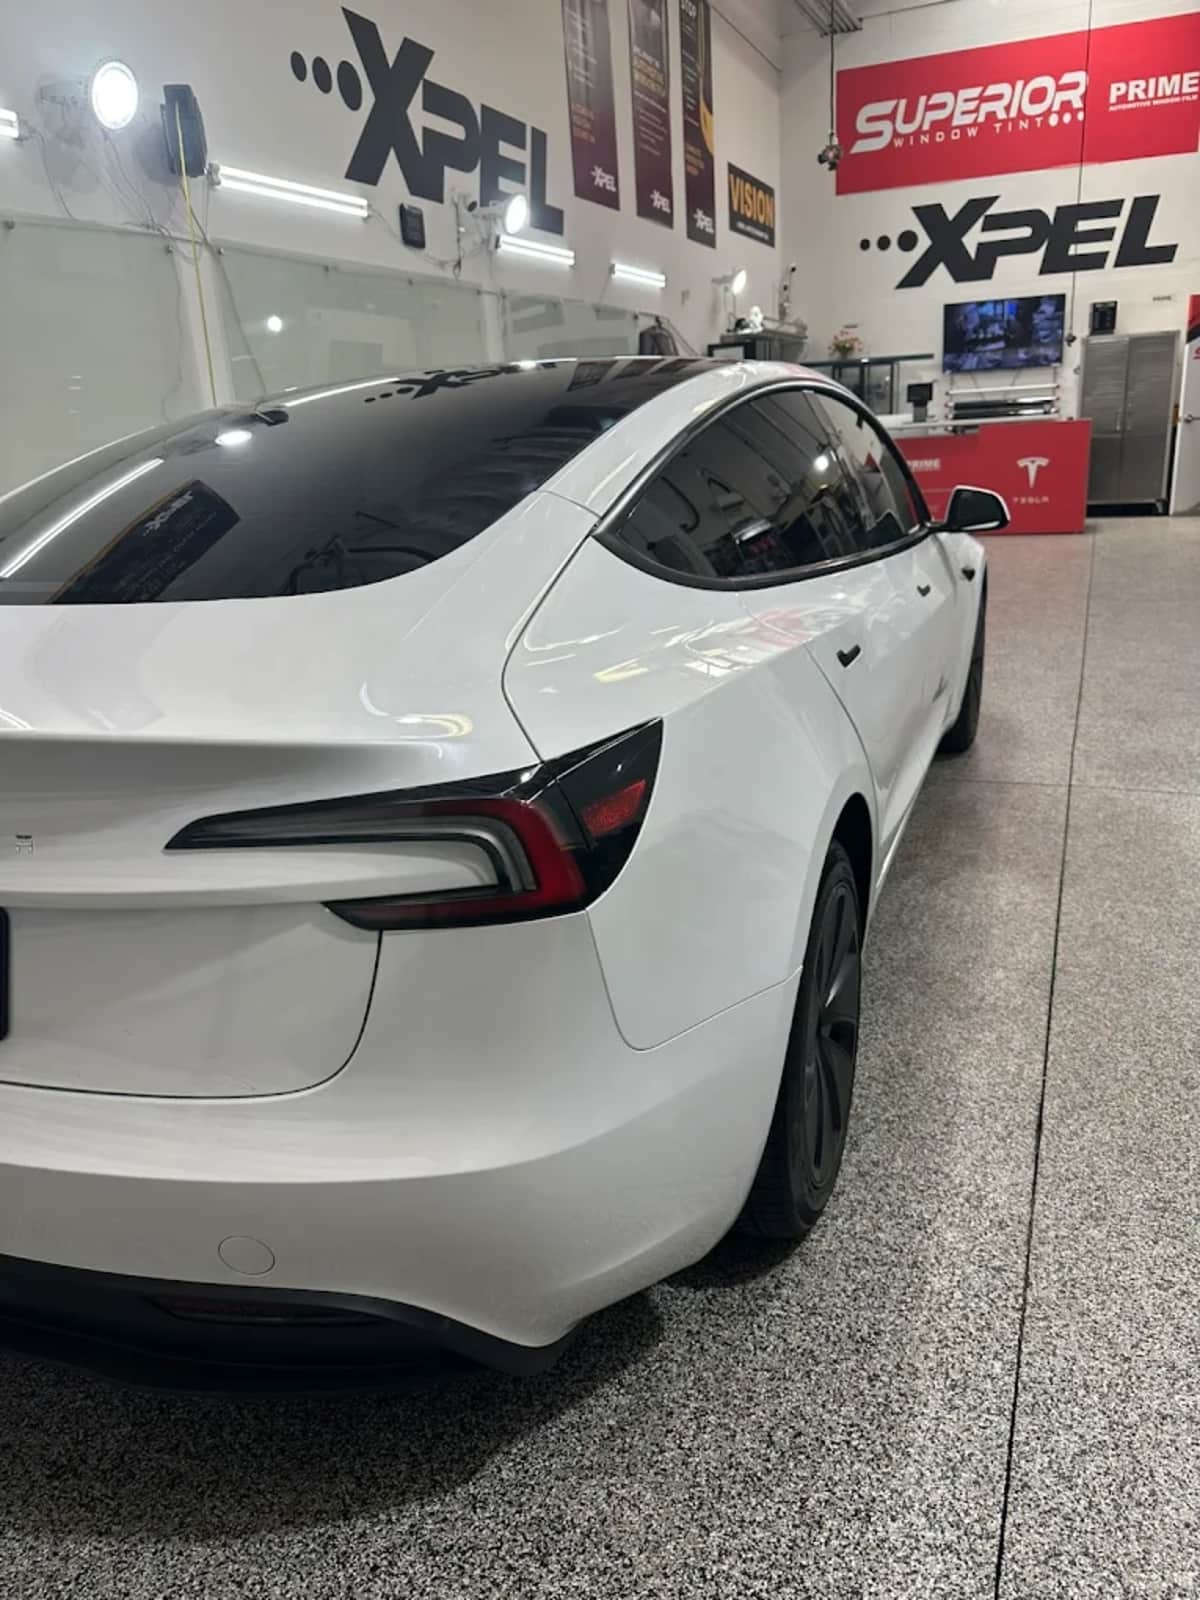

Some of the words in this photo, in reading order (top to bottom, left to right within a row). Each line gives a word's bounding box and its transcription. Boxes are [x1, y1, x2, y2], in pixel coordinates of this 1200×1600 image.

[850, 70, 1089, 154] SUPERIOR
[1109, 70, 1200, 104] PRIME
[341, 6, 564, 236] XPEL
[893, 127, 978, 148] WINDOW
[994, 116, 1043, 134] TINT
[591, 165, 617, 193] XPEL
[729, 173, 774, 229] VISION
[894, 194, 1179, 290] XPEL
